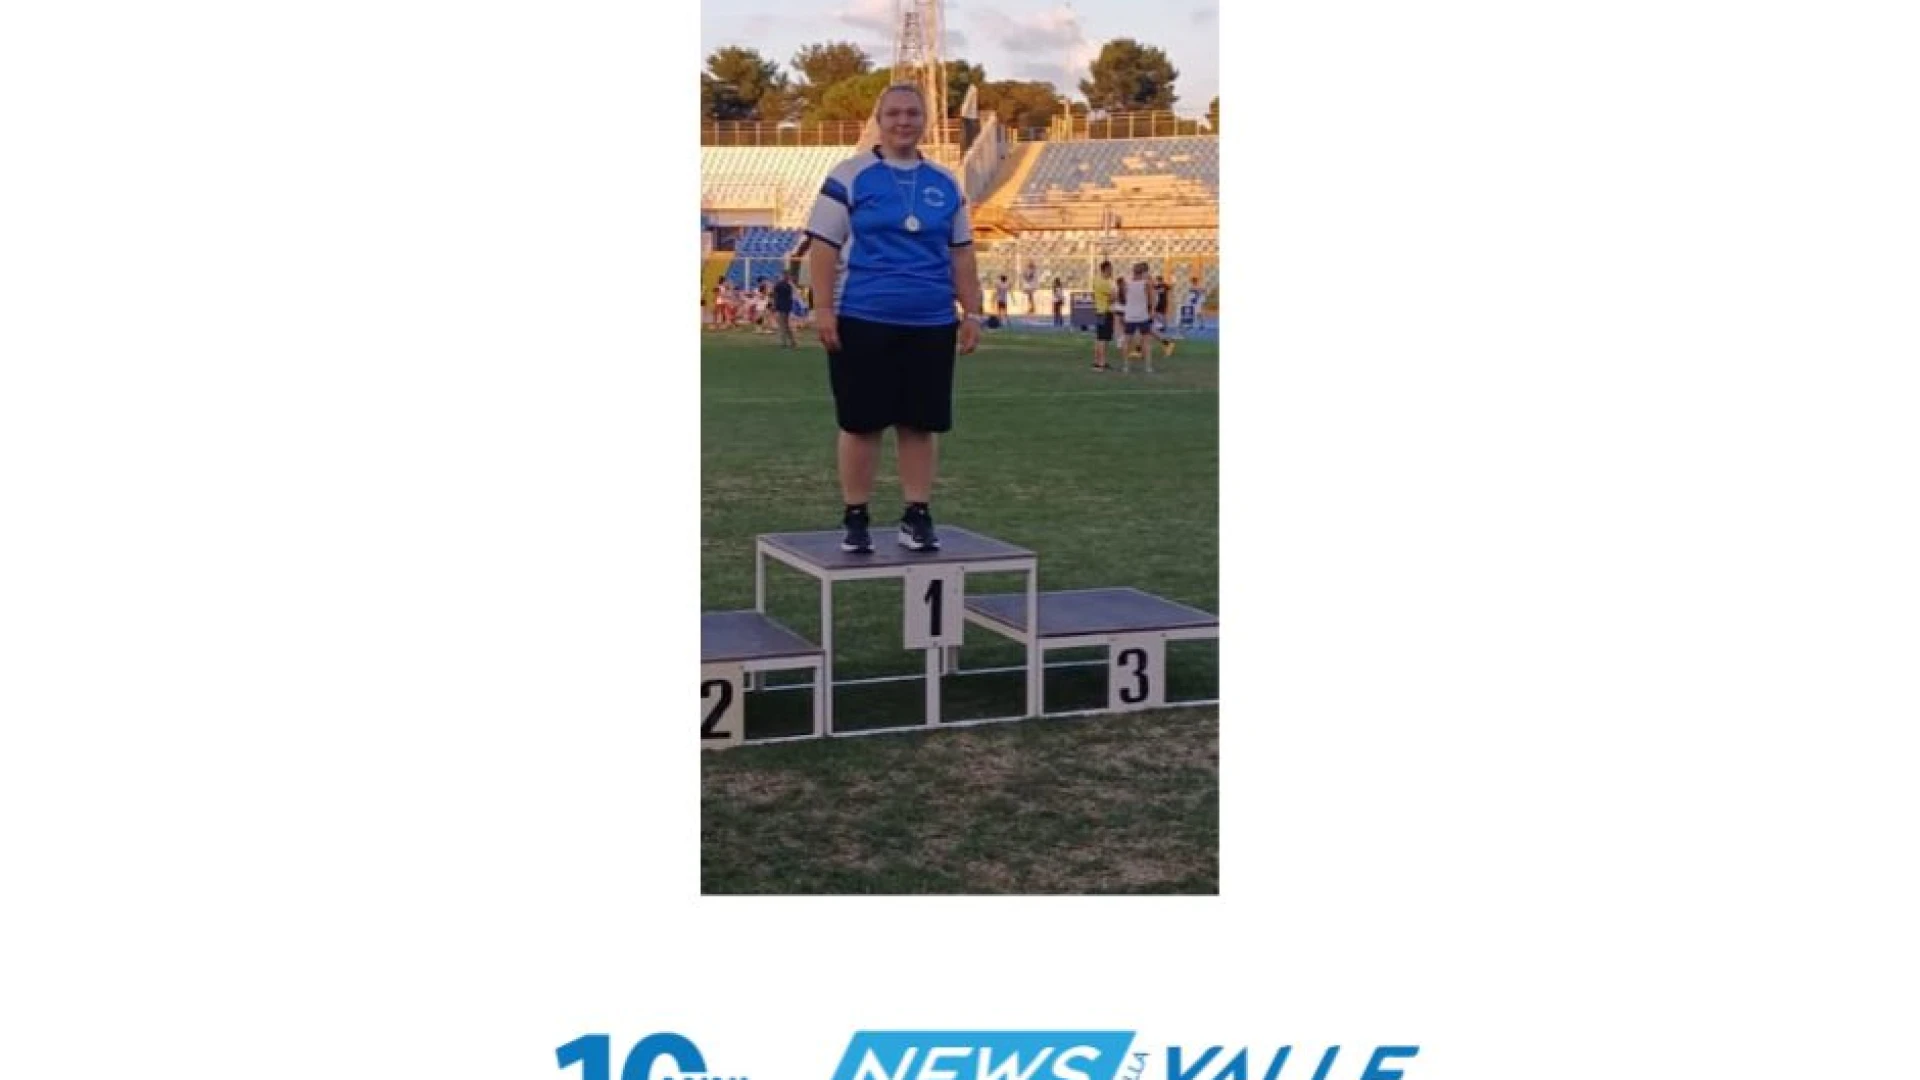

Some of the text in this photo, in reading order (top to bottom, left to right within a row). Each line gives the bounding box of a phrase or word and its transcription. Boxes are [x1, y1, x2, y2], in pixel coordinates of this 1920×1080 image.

[924, 579, 943, 636] 1
[1117, 648, 1149, 703] 3
[701, 679, 733, 739] 2
